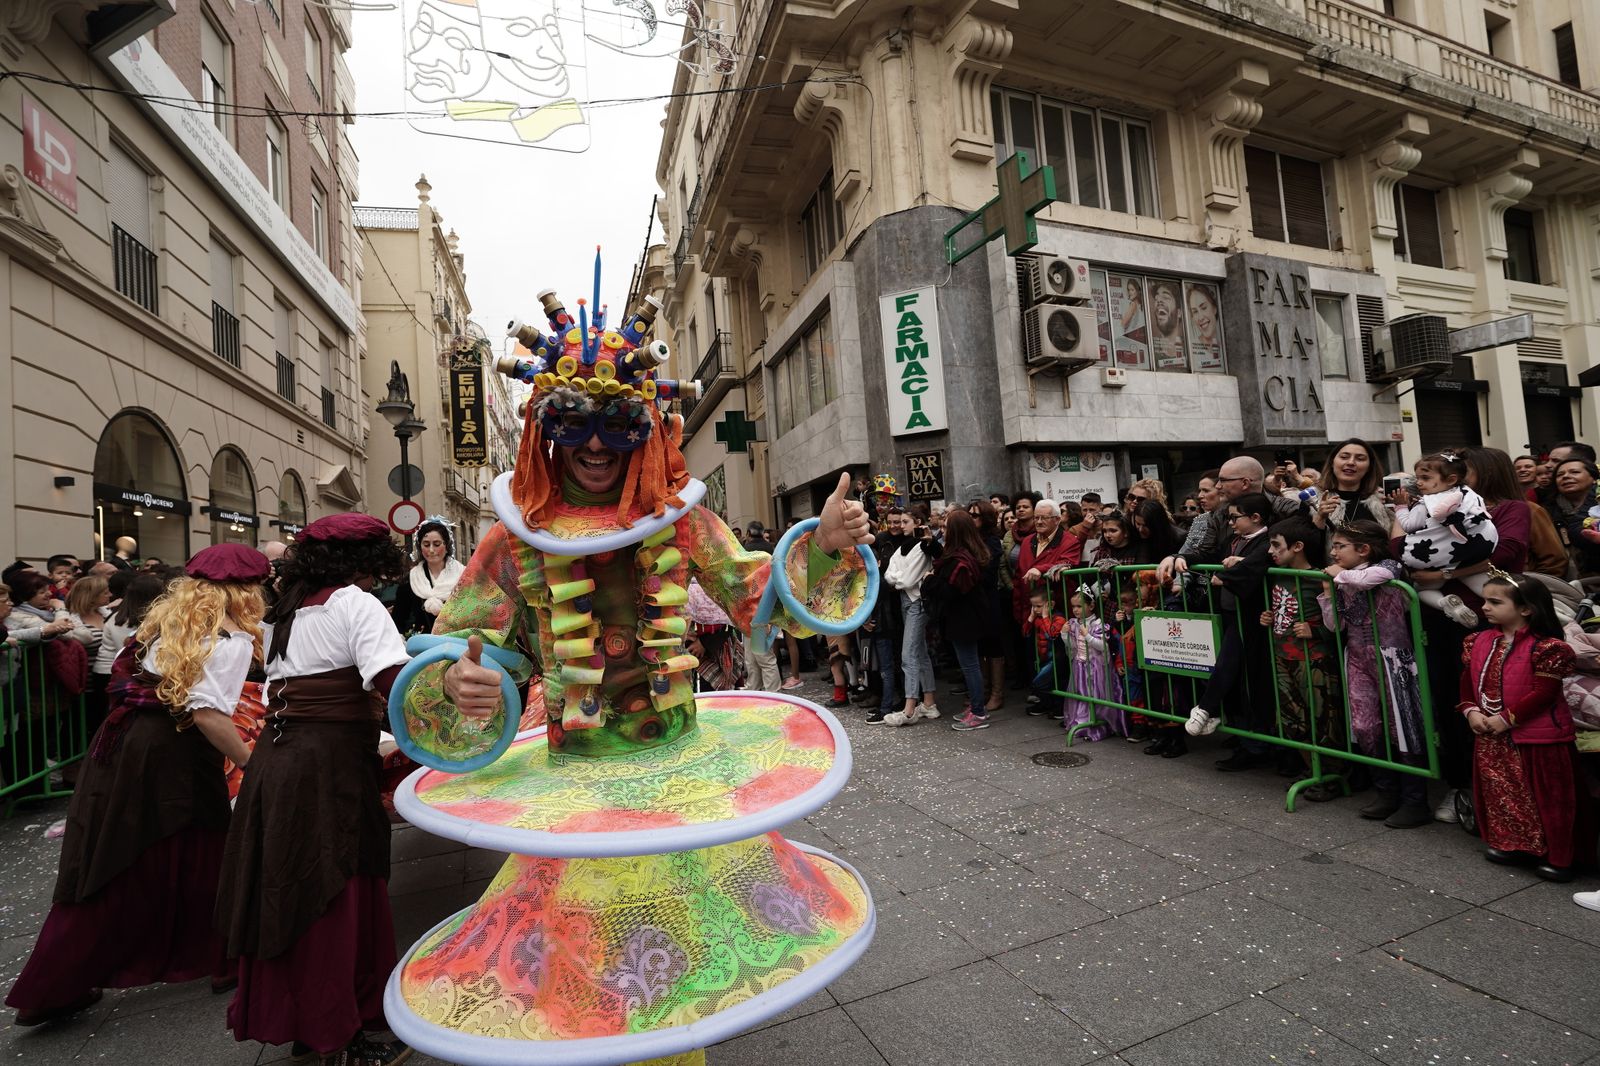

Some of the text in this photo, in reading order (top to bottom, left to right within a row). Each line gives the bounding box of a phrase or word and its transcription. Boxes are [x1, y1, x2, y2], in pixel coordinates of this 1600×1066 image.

[1250, 267, 1310, 309] FAR
[895, 293, 932, 430] FARMACIA
[1264, 375, 1324, 412] CIA
[458, 373, 478, 445] EMFISA
[909, 456, 939, 470] FAR
[911, 469, 936, 482] MA
[912, 481, 942, 496] CIA
[122, 492, 144, 502] ALVARO
[152, 498, 174, 508] MORENO
[1148, 640, 1179, 648] AYUNTAMIENTO
[1171, 648, 1208, 658] Infraestructuras
